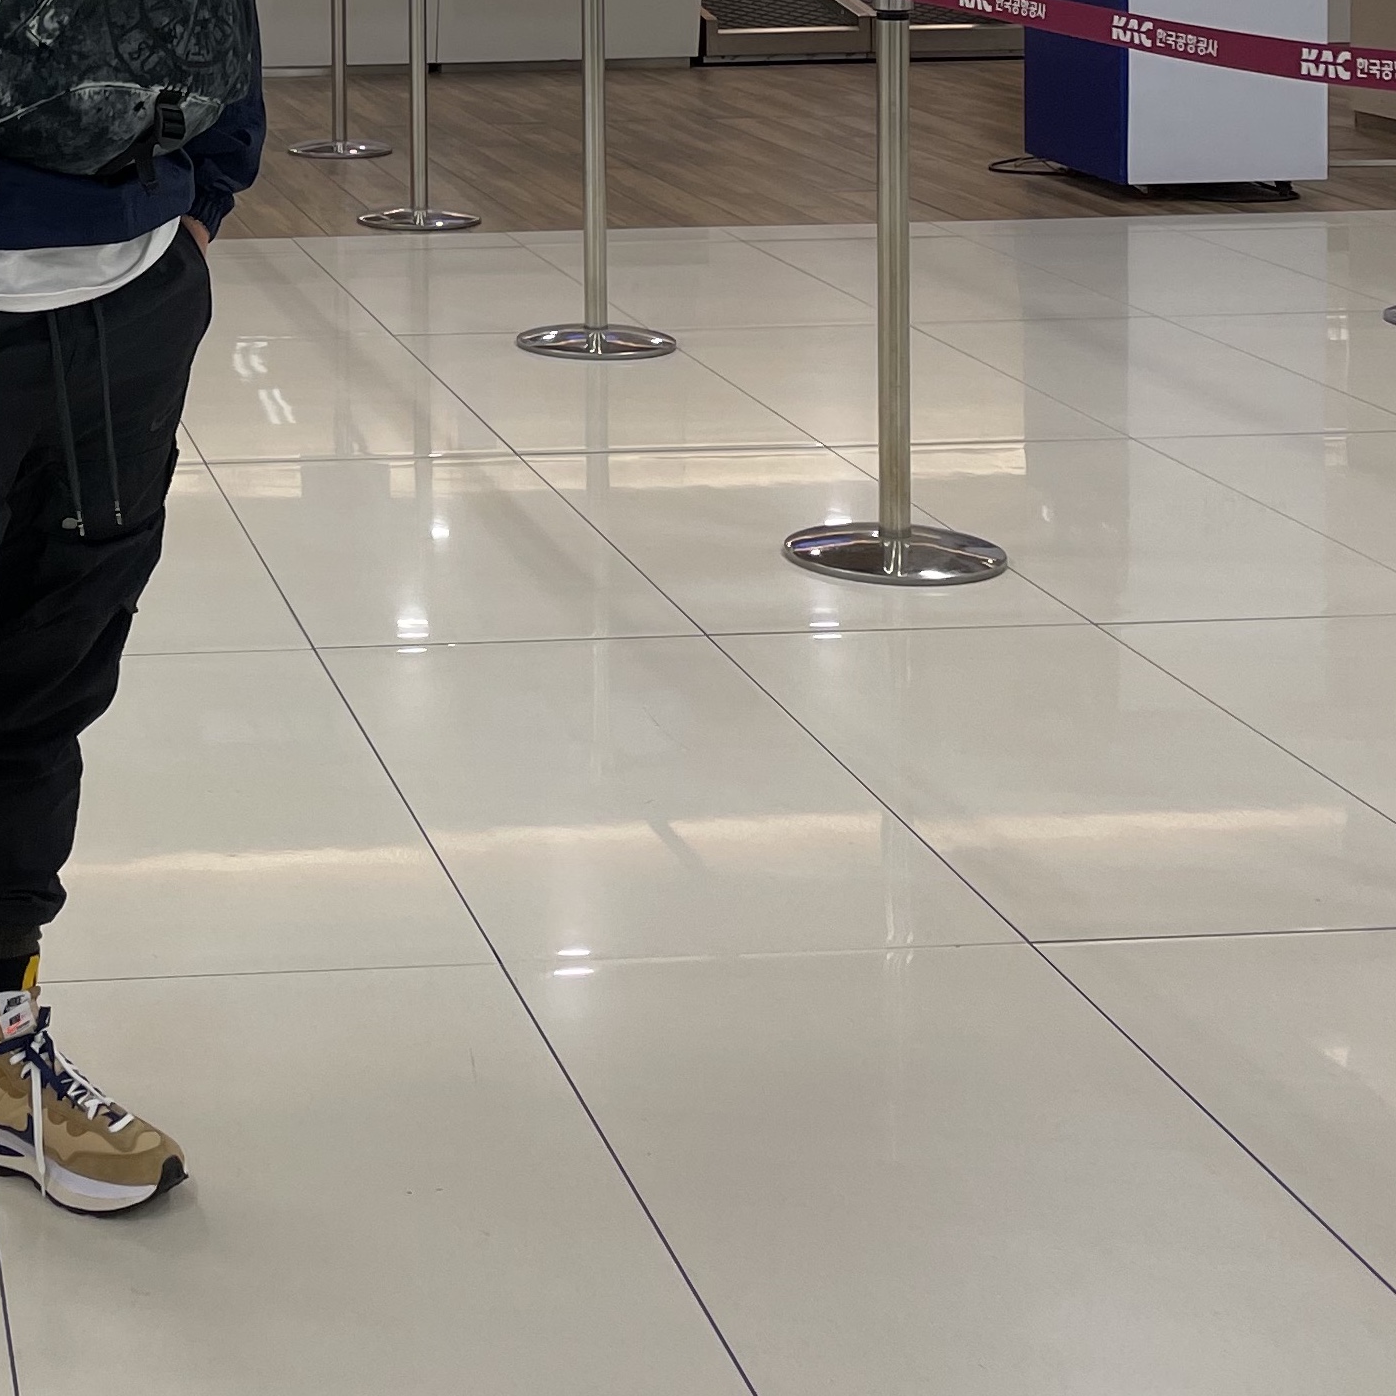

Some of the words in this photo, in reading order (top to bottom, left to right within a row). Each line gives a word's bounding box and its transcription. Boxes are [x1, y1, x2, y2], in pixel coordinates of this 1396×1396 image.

[1112, 15, 1154, 47] KAC
[1156, 28, 1219, 58] 한국공항공사
[1300, 48, 1352, 81] KAC
